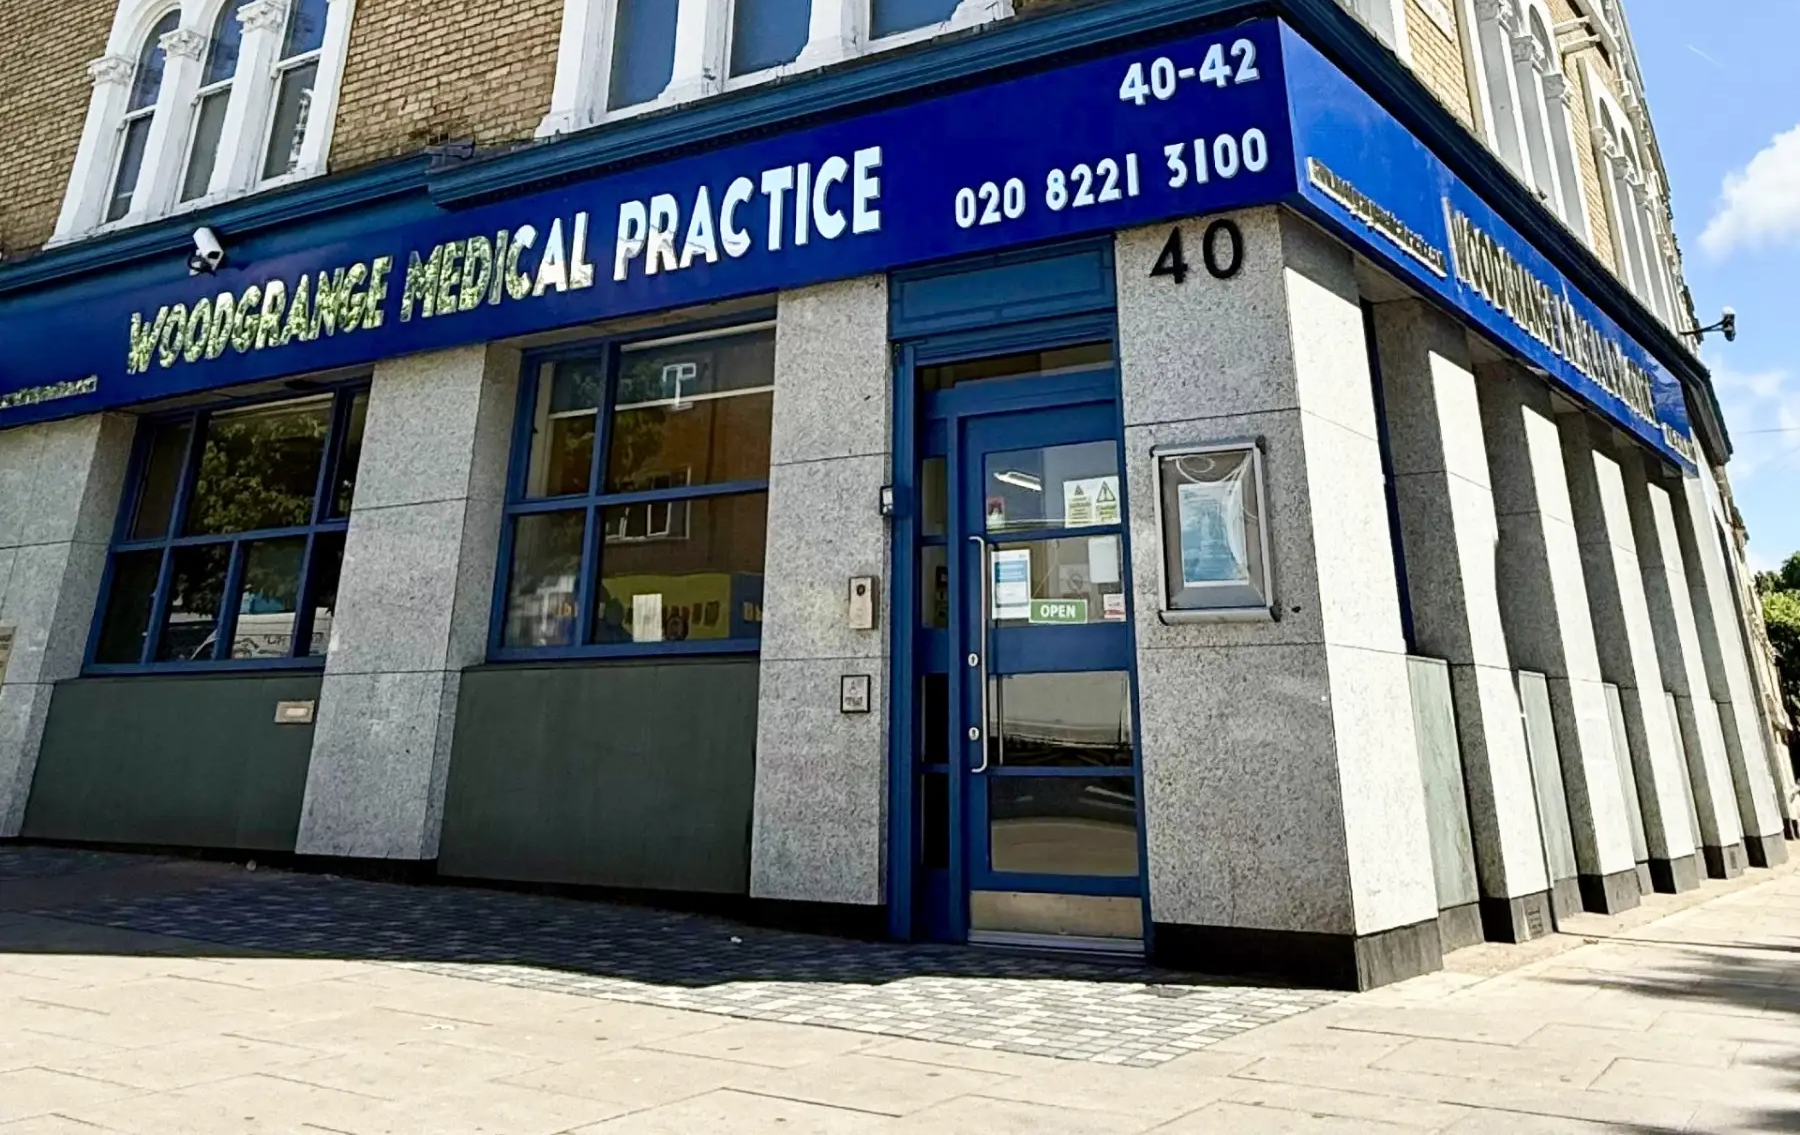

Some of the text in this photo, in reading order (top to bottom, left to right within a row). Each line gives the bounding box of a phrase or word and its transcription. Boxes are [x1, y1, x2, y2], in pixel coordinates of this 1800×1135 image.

[1119, 38, 1260, 105] 40-42
[955, 127, 1268, 228] 020 8221 3100
[126, 145, 882, 375] WOODGRANGE MEDICAL PRACTICE
[1149, 218, 1243, 284] 40
[1040, 604, 1077, 619] OPEN
